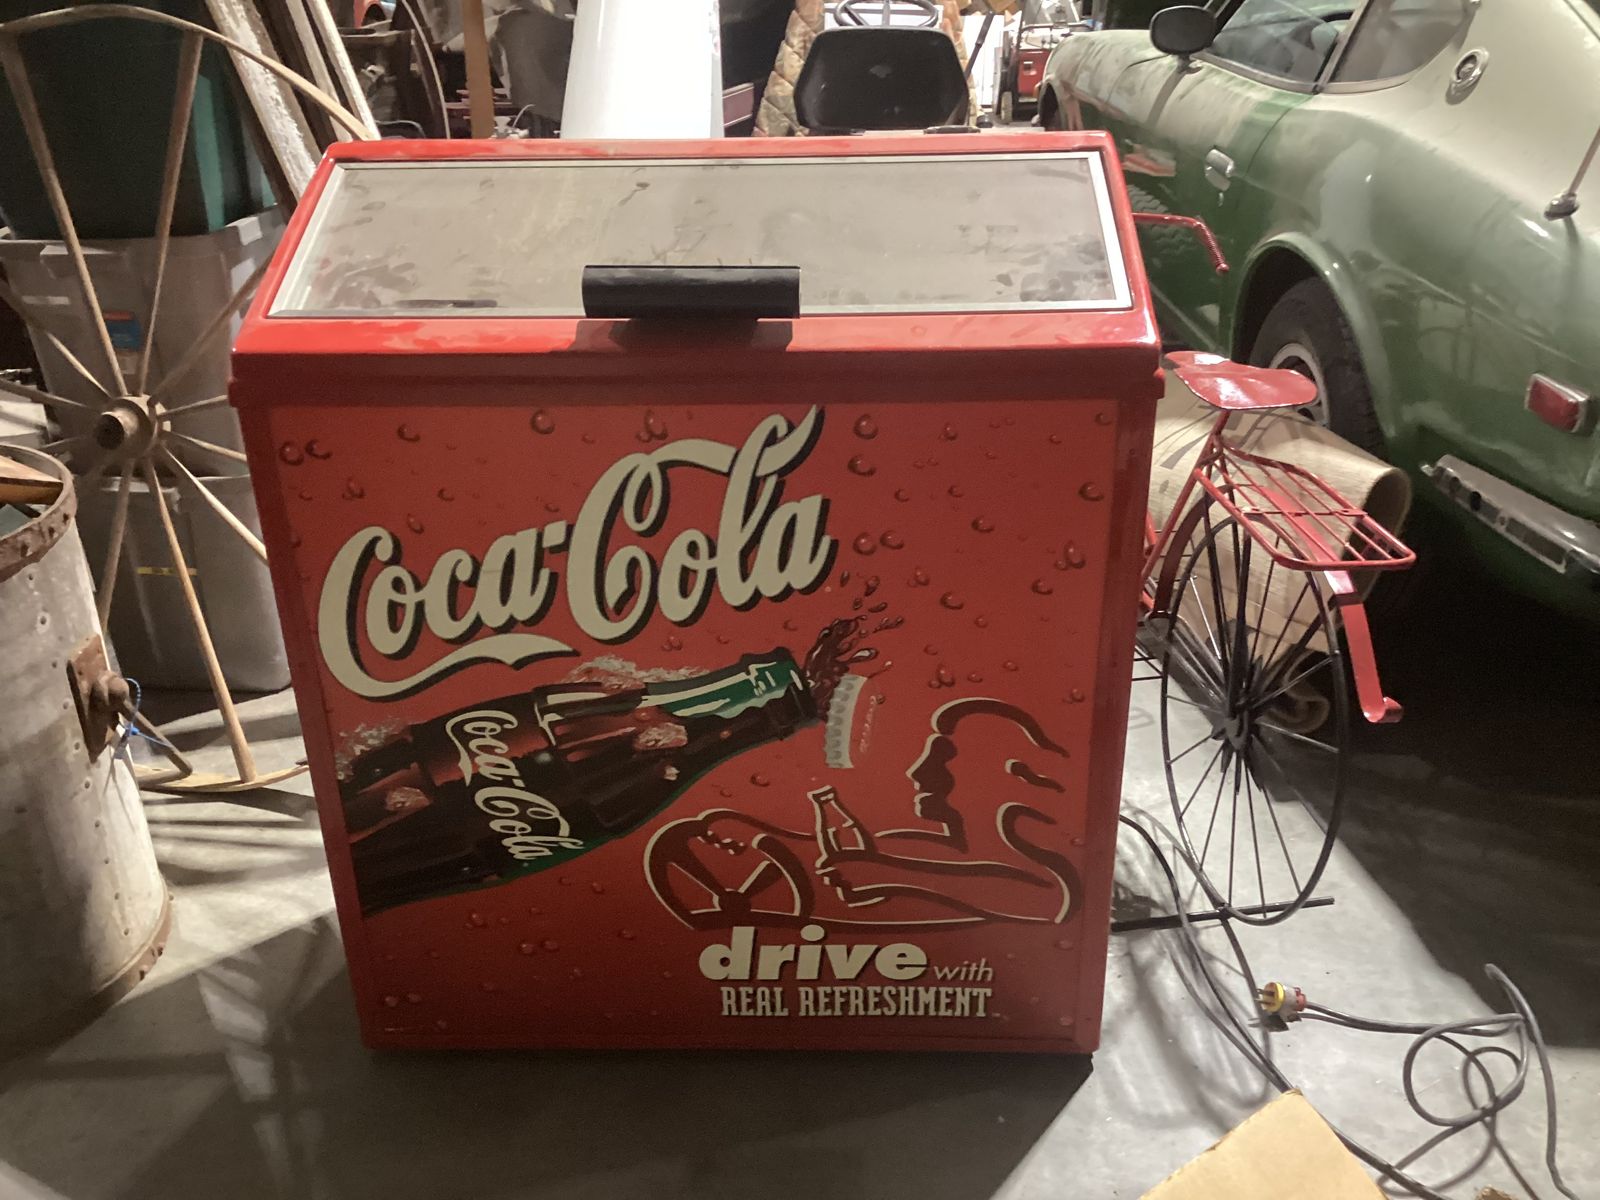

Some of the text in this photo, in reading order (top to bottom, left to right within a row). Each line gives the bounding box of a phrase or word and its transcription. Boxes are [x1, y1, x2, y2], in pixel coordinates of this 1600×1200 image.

[318, 404, 836, 699] Coca-Cola
[445, 709, 585, 860] Coca-Cola
[699, 924, 994, 982] drive with
[720, 986, 992, 1018] REAL REFRESHMENT
